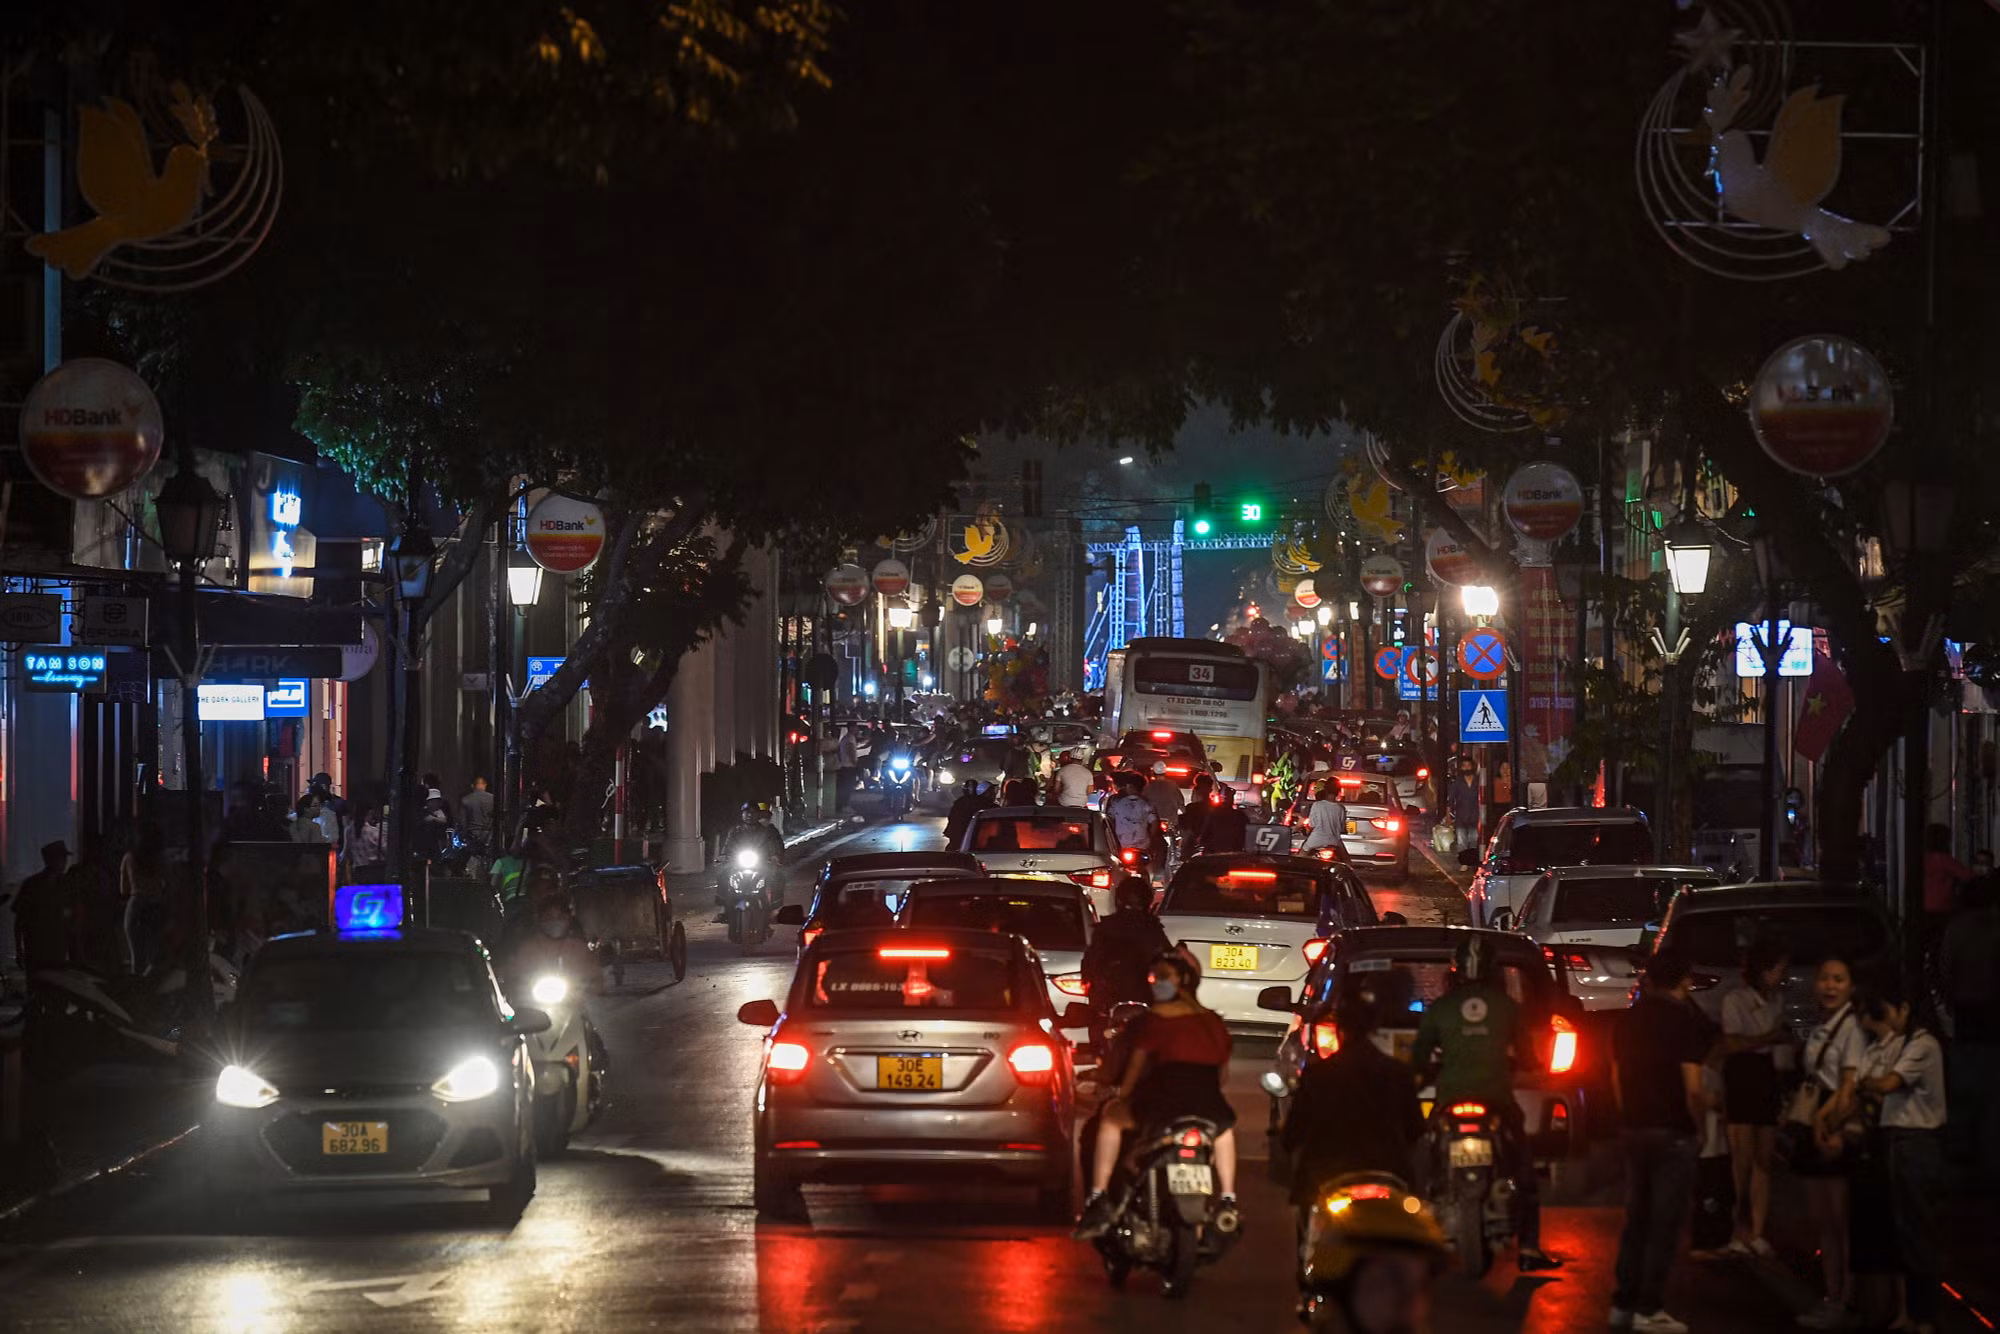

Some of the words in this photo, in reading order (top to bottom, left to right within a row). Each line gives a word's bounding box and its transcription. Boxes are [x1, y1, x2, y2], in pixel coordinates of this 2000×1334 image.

[45, 408, 123, 426] HDBank
[1518, 490, 1562, 500] HDBank
[1242, 504, 1261, 520] 30
[540, 520, 584, 531] HDBank
[26, 656, 62, 670] TAM
[1192, 667, 1210, 680] 34
[1256, 828, 1280, 851] G7
[1224, 947, 1243, 957] 30A
[897, 1059, 924, 1072] 30E
[887, 1073, 935, 1088] 149.24
[341, 1123, 368, 1137] 30A
[330, 1138, 380, 1153] 682.96
